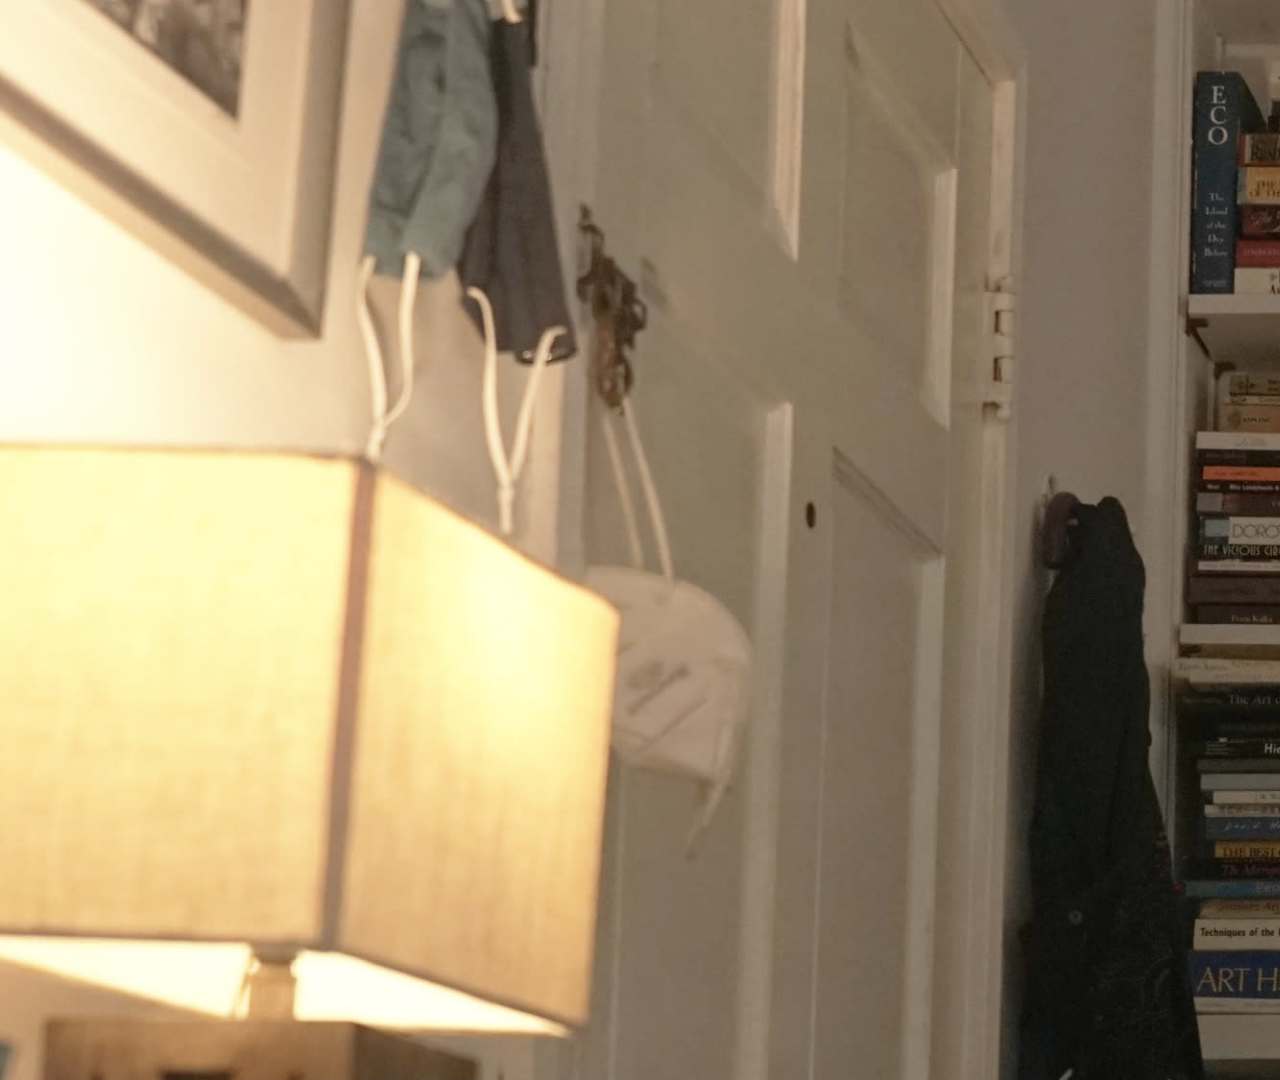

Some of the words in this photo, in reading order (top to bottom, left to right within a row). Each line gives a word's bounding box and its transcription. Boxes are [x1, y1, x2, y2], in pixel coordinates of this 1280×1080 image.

[1222, 544, 1262, 557] VICIOUS
[1200, 927, 1246, 938] Techniques
[1249, 927, 1258, 937] of
[1261, 927, 1275, 937] the
[1196, 966, 1254, 994] ART
